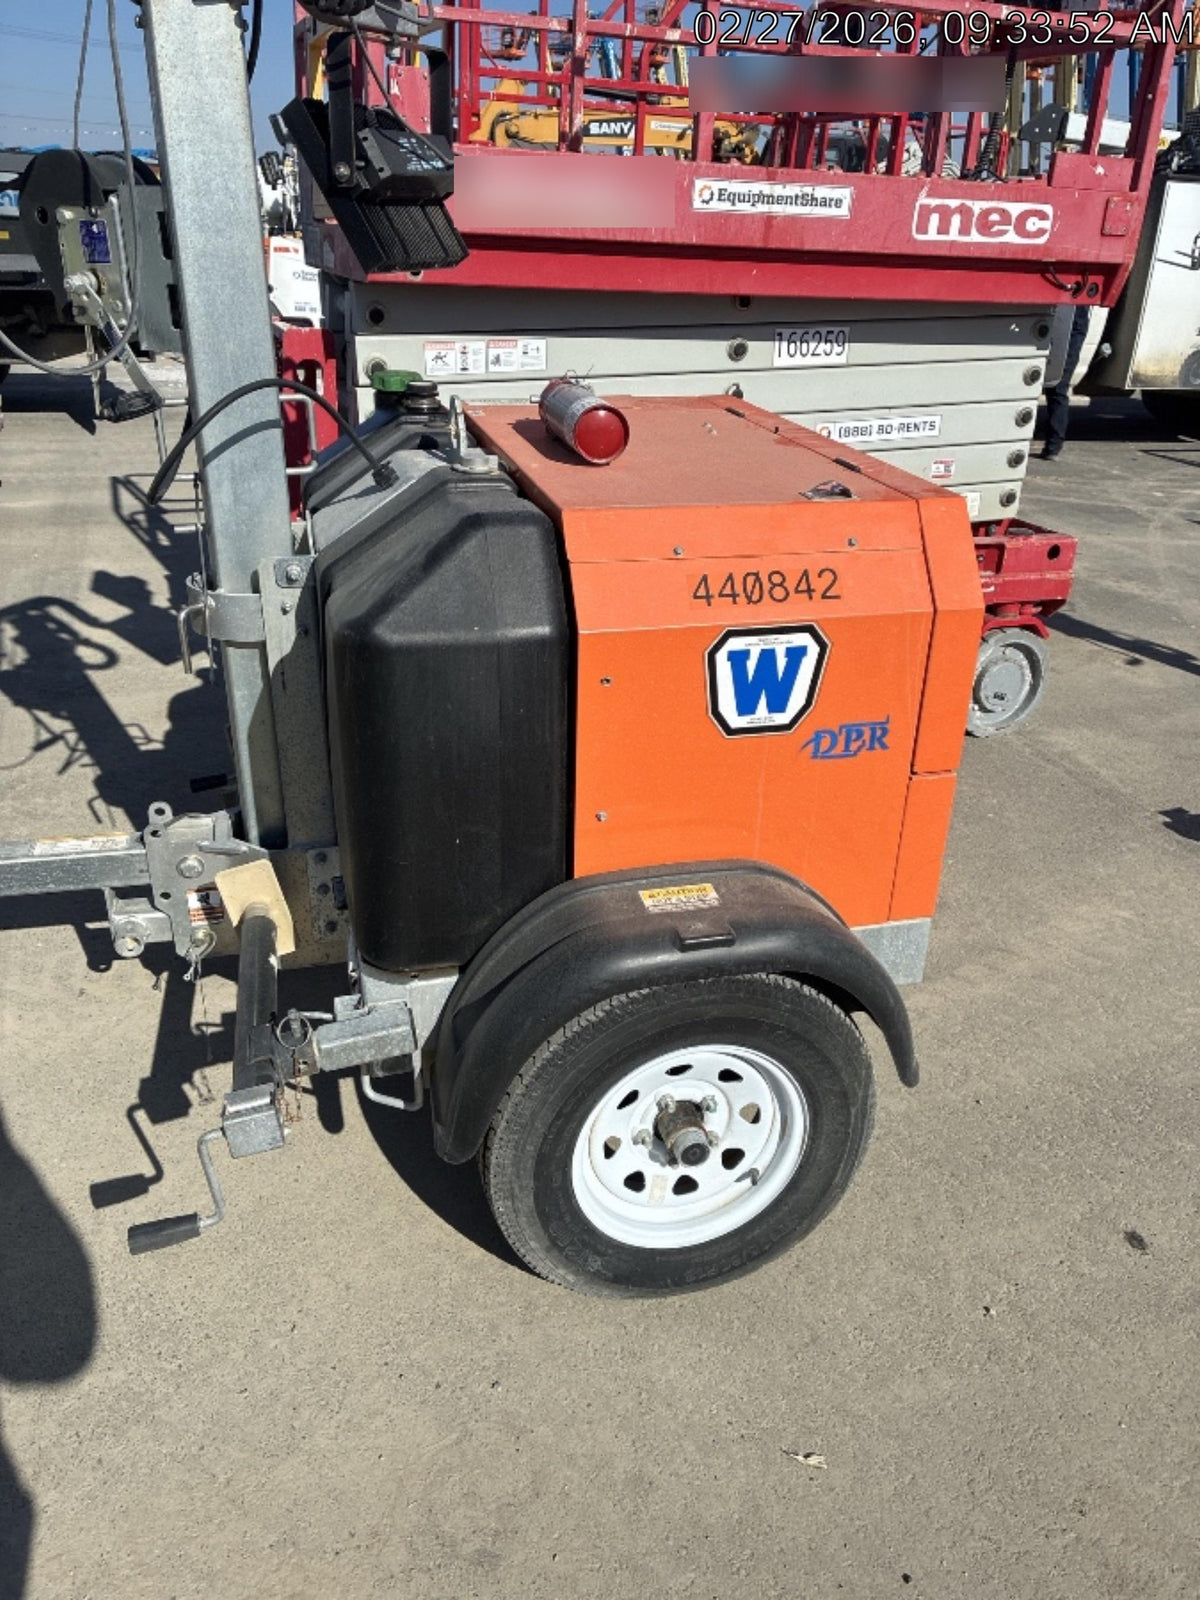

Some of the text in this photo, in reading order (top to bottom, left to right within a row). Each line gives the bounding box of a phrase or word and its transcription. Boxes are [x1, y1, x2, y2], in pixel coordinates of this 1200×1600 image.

[589, 121, 632, 135] SANY
[716, 187, 843, 209] EquipmentShare
[914, 201, 1052, 240] mec
[776, 329, 847, 357] 166259
[692, 568, 841, 607] 440842
[726, 645, 808, 716] W
[803, 716, 890, 760] DPR
